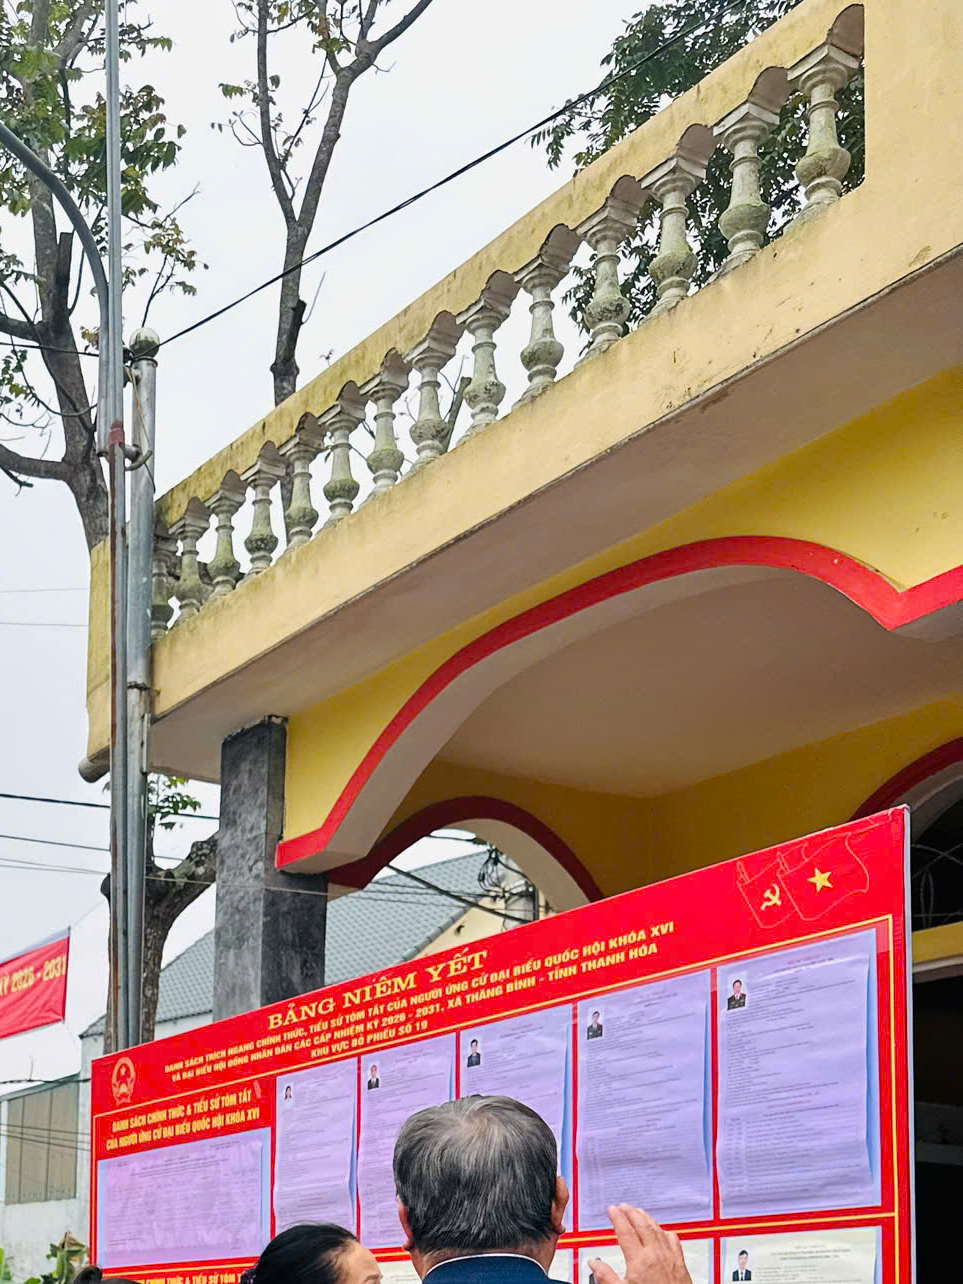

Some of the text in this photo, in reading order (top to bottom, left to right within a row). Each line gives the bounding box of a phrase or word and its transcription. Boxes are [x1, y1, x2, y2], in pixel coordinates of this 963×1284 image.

[11, 966, 35, 993] 2026
[43, 954, 67, 982] 2031
[268, 947, 488, 1030] BẢNG NIÊM YẾT
[164, 1060, 184, 1074] DANH
[184, 1055, 204, 1068] SÁCH
[227, 1042, 255, 1057] NGANG
[256, 1034, 282, 1049] CHÍNH
[345, 1010, 366, 1024] TÓM
[386, 996, 408, 1012] CỦA
[410, 986, 443, 1006] NGƯỜI
[445, 978, 469, 996] ỨNG
[471, 972, 488, 988] CỬ
[489, 968, 511, 984] ĐẠI
[513, 958, 542, 977] BIỂU
[544, 946, 580, 968] QUỐC
[582, 940, 606, 958] HỘI
[608, 929, 647, 950] KHÓA
[650, 920, 675, 938] XVI
[294, 1036, 312, 1051] CÁC
[313, 1030, 332, 1045] CẤP
[333, 1024, 365, 1041] NHIỆM
[381, 1013, 406, 1028] 2026
[506, 975, 537, 994] BÌNH
[547, 963, 578, 982] TỈNH
[580, 951, 626, 973] THANH
[629, 941, 658, 960] HÓA
[310, 1043, 330, 1059] KHU
[366, 1024, 396, 1044] PHIẾU
[398, 1018, 413, 1035] SỐ
[414, 1019, 428, 1033] 19
[129, 1113, 147, 1129] SÁCH
[186, 1105, 192, 1116] &
[191, 1114, 211, 1133] QUỐC
[225, 1107, 246, 1125] KHÓA
[246, 1106, 260, 1121] XVI
